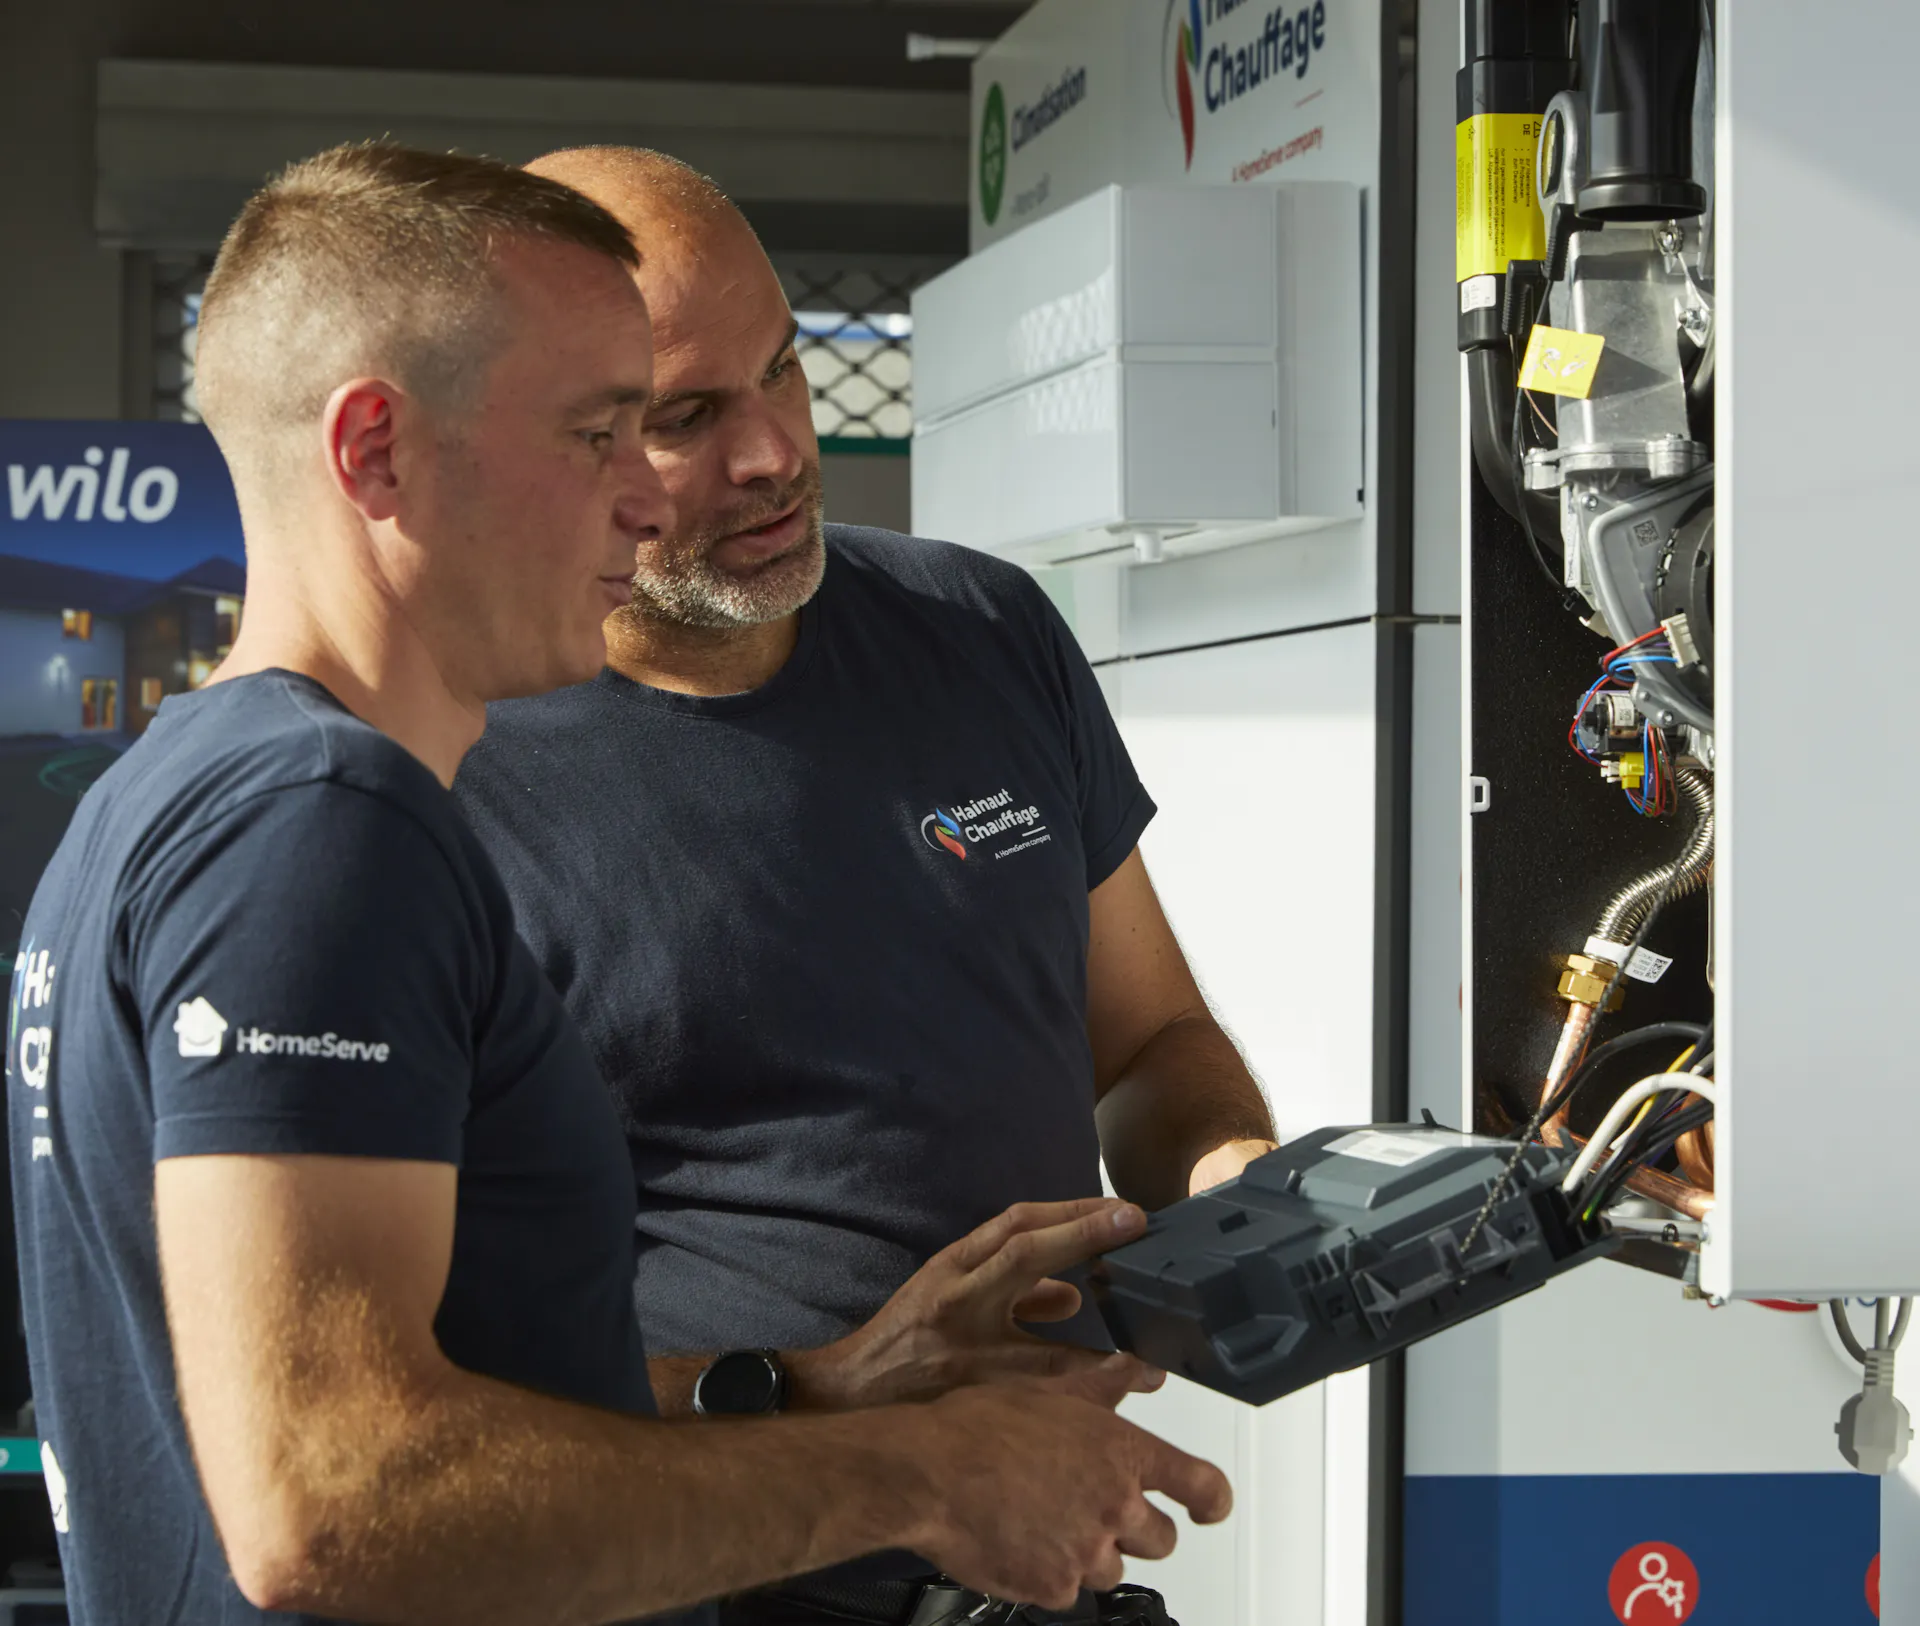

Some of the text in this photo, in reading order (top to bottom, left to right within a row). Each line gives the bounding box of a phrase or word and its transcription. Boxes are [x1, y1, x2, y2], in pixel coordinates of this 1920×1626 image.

[1205, 0, 1325, 113] Chauffage
[1523, 124, 1530, 135] DE
[6, 446, 179, 523] wilo
[951, 788, 1014, 823] Hainaut
[964, 804, 1040, 843] Chauffage
[1000, 842, 1030, 858] HomeServe
[236, 1026, 390, 1063] HomeServe
